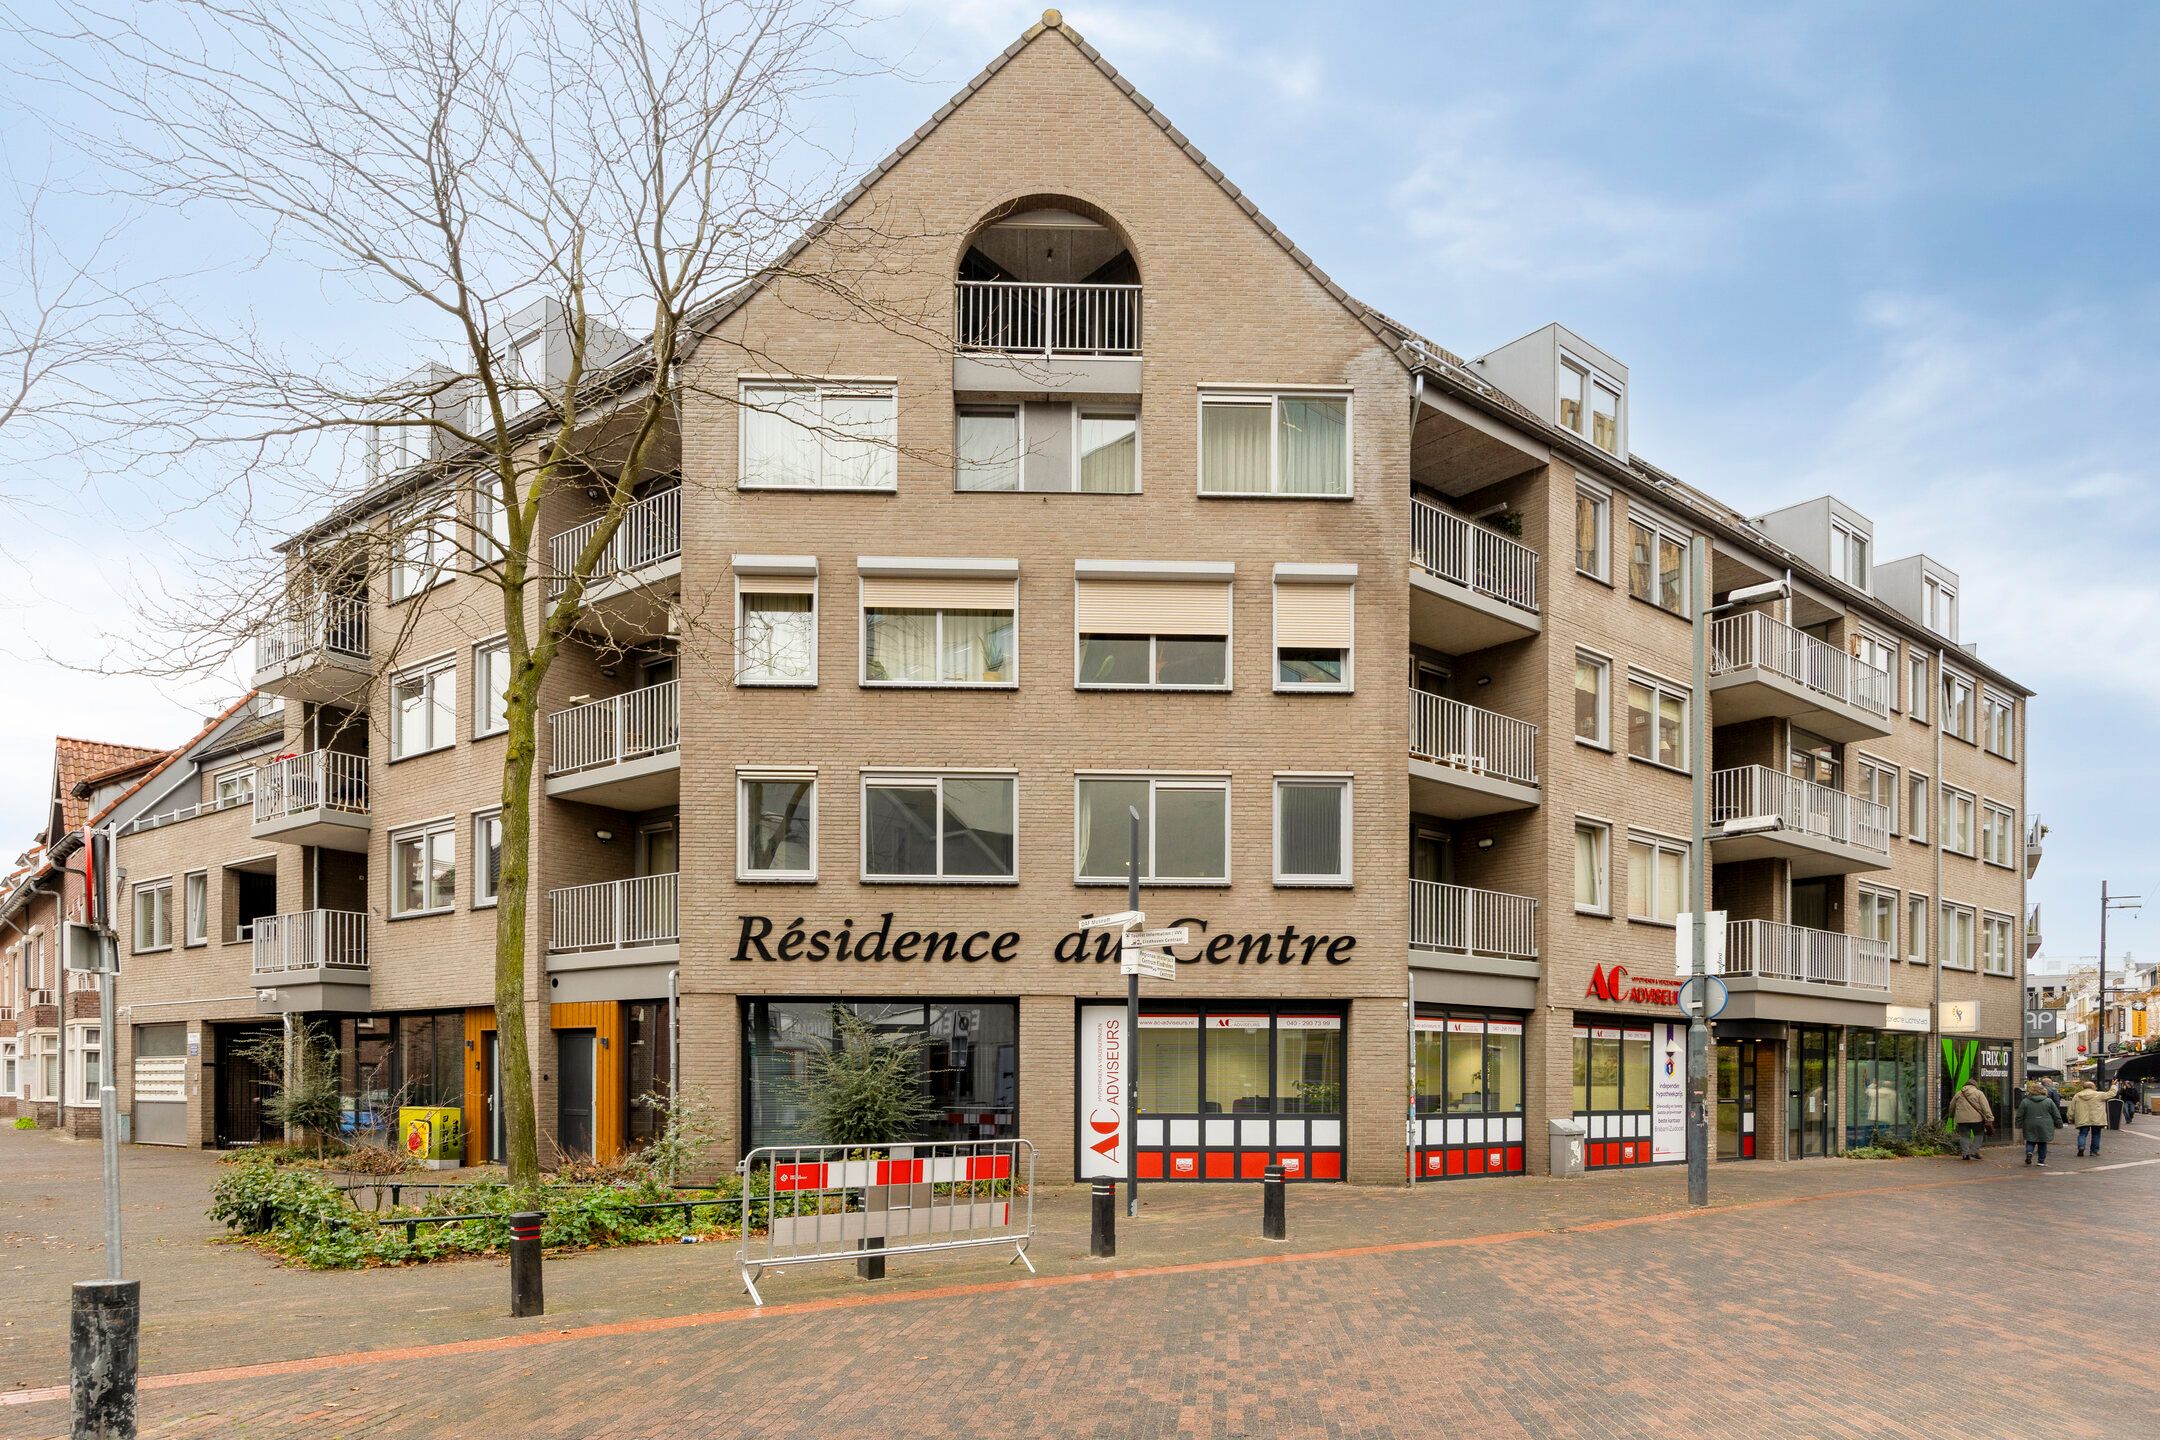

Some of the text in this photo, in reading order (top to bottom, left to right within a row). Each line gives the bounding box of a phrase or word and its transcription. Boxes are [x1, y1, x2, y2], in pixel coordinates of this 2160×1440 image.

[1091, 917, 1111, 925] Museum
[730, 912, 1357, 965] Résidence du Centre
[1585, 962, 1629, 1001] AC
[1629, 987, 1679, 1005] ADVISEU
[1216, 1019, 1233, 1027] AC
[1106, 1019, 1120, 1105] ADVISEURS
[1980, 1050, 2009, 1066] TRIXXO
[1089, 1107, 1121, 1164] AC
